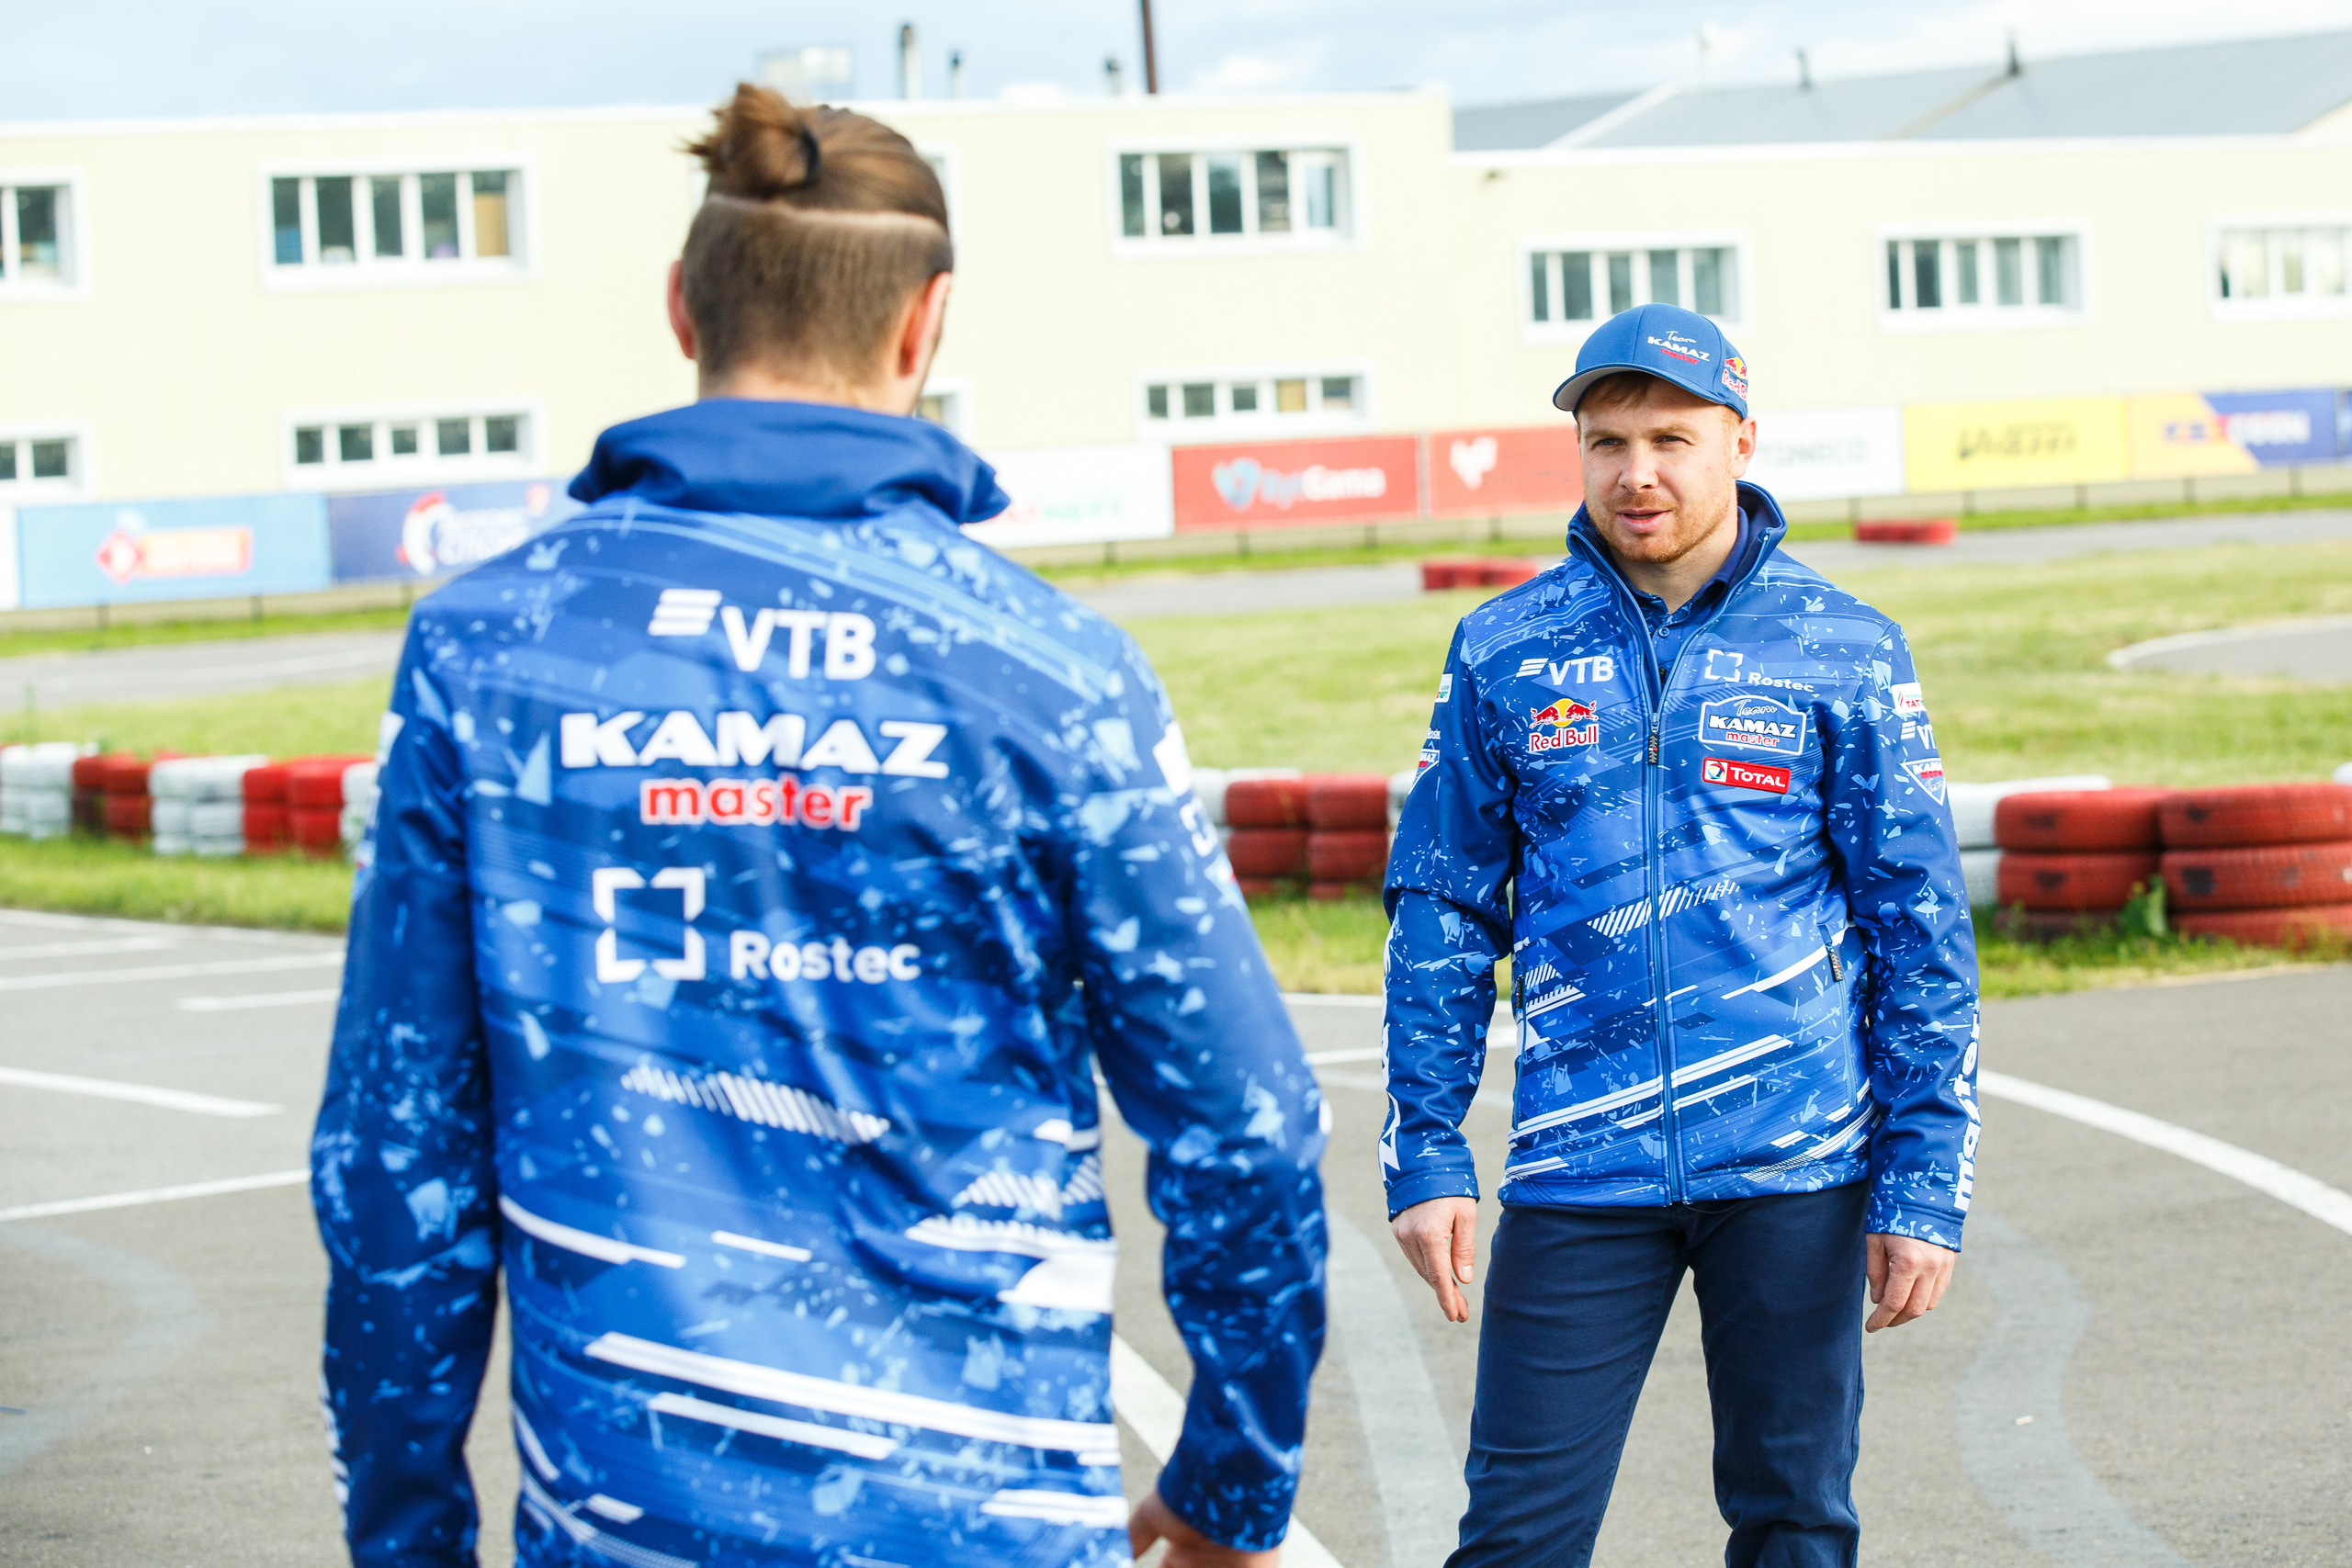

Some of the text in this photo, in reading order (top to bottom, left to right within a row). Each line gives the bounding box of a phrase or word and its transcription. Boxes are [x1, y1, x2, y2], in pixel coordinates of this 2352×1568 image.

[1647, 336, 1710, 362] KAMAZ
[1666, 331, 1697, 344] Team
[1661, 348, 1699, 365] master
[720, 606, 876, 681] VTB
[1550, 656, 1614, 686] VTB
[1748, 671, 1815, 693] Rostec
[1734, 699, 1778, 716] Team
[1529, 724, 1600, 752] Red Bull
[1709, 715, 1797, 739] KAMAZ
[560, 711, 949, 779] KAMAZ
[1726, 732, 1780, 748] master
[1730, 766, 1786, 787] TOTAL
[640, 773, 872, 831] master
[730, 930, 922, 984] Rostec
